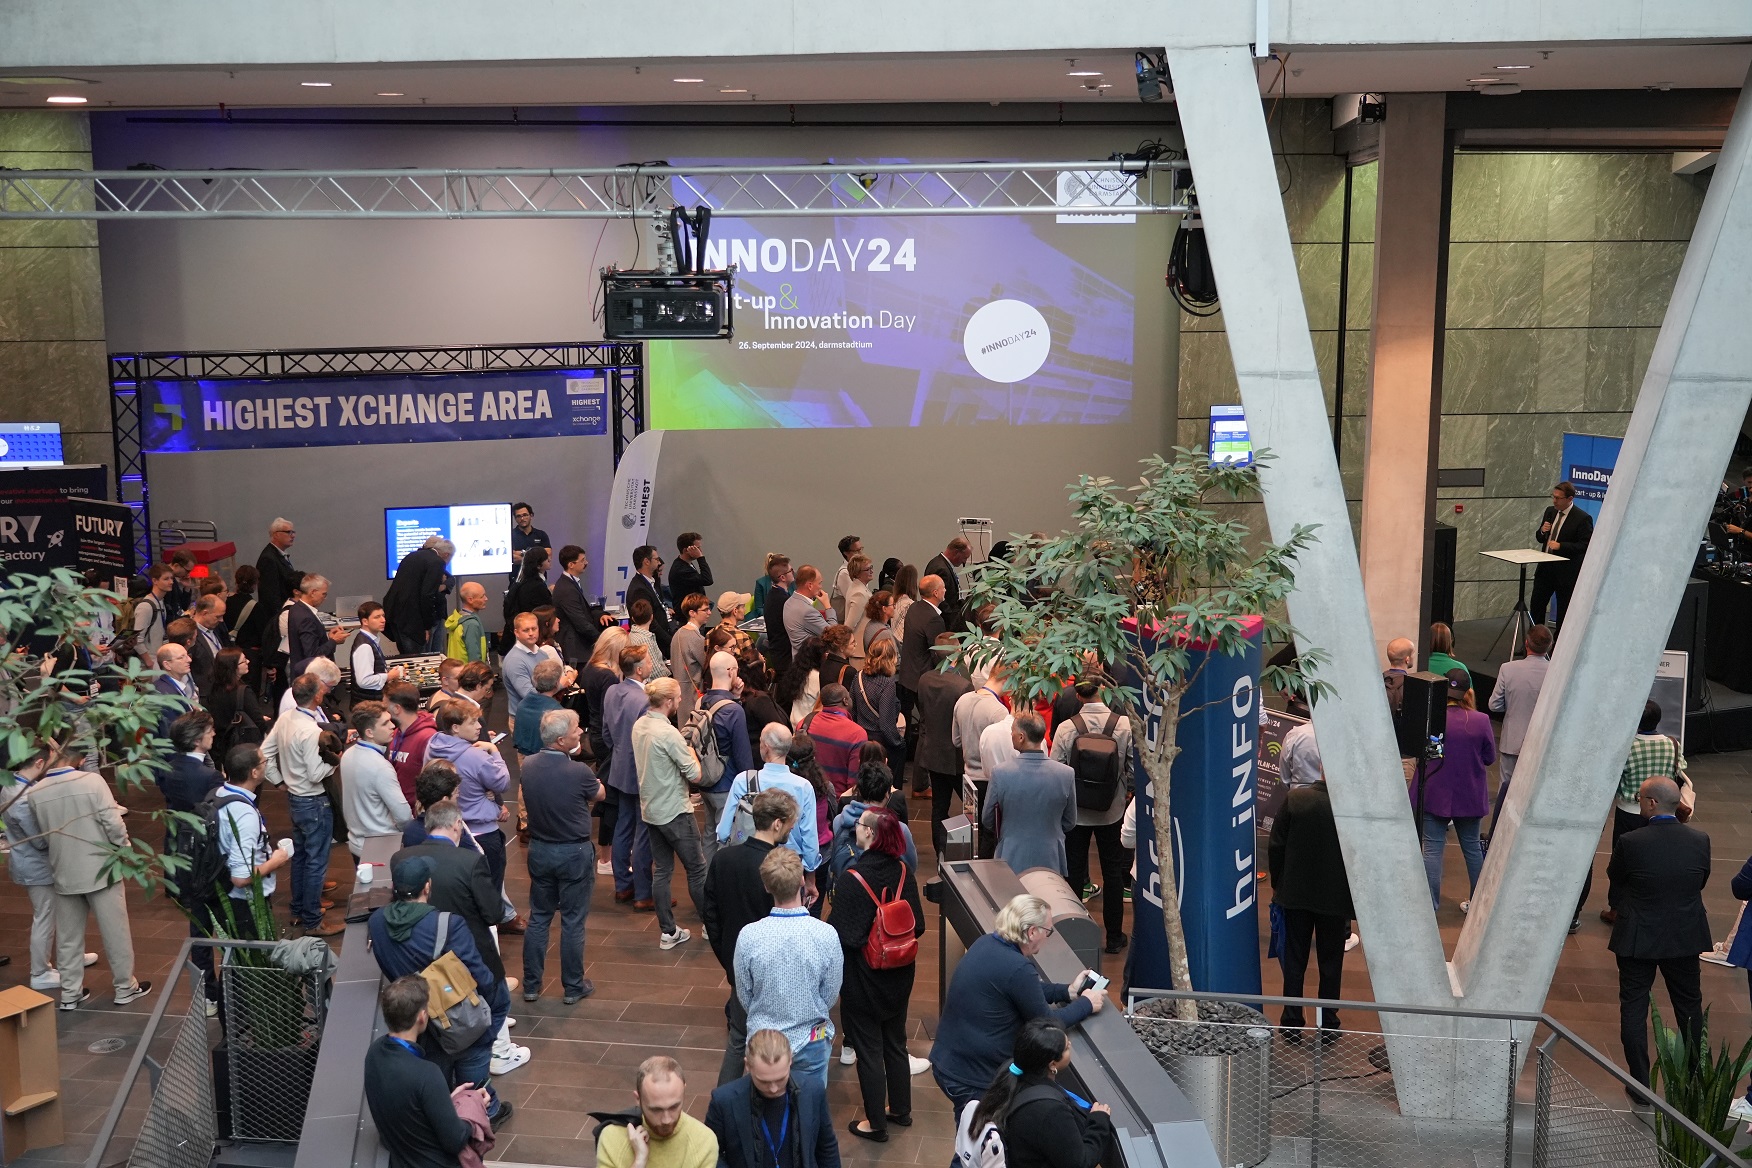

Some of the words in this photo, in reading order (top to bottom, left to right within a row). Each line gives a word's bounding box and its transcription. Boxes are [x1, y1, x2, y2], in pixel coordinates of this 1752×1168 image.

[689, 238, 917, 272] INNODAY24
[779, 283, 799, 310] &
[764, 311, 873, 330] Innovation
[879, 310, 916, 332] Day
[738, 341, 751, 350] 26.
[752, 341, 794, 351] September
[795, 341, 818, 350] 2024,
[818, 340, 873, 349] darmstadtium
[981, 329, 1037, 355] #INNODAY24
[203, 396, 332, 431] HIGHEST
[337, 393, 474, 428] XCHANGE
[480, 389, 553, 421] AREA
[571, 398, 600, 406] HIGHEST
[572, 416, 601, 426] xchange
[1572, 467, 1612, 485] InnoDay
[69, 486, 89, 494] bring
[640, 479, 651, 527] HIGHEST
[75, 514, 124, 537] FUTURY
[1232, 674, 1253, 828] iNFO
[1226, 848, 1253, 920] hr
